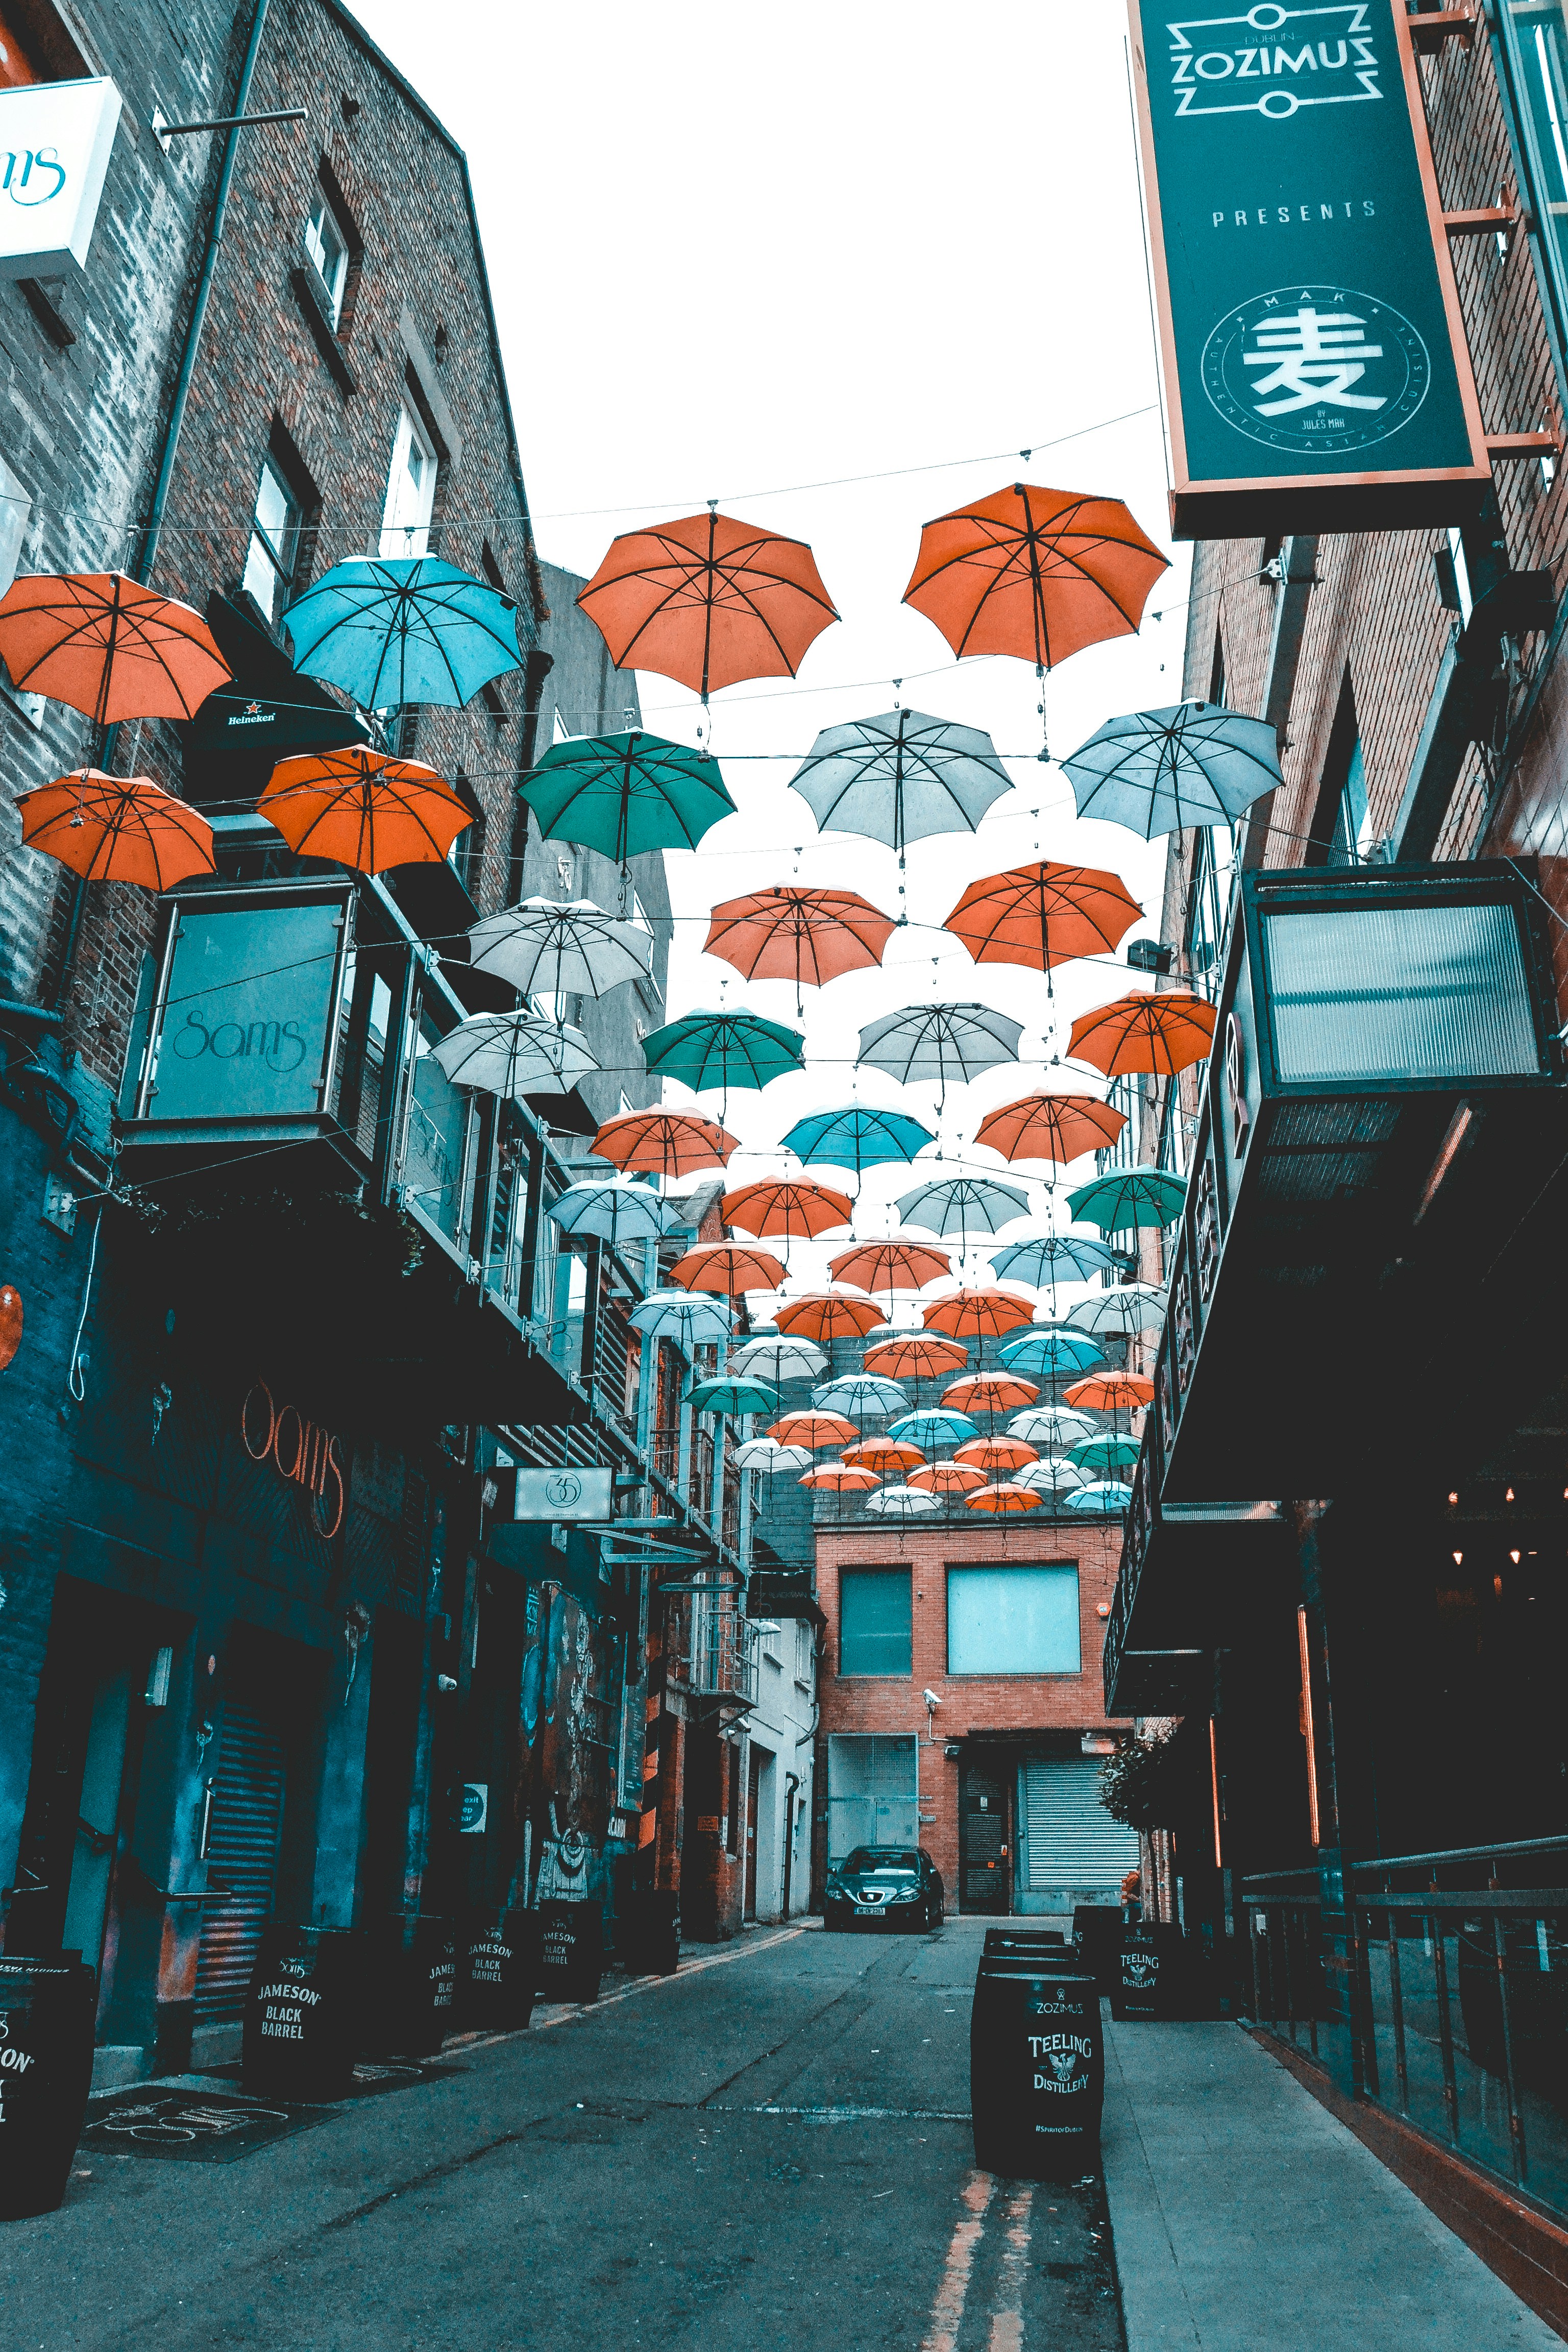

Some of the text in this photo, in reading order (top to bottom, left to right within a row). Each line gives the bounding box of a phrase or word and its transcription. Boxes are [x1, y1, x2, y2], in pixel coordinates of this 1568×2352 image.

[1244, 32, 1295, 45] DUBLIN
[1170, 37, 1379, 83] ZOZIMUS
[1212, 201, 1376, 228] PRESENTS
[1264, 290, 1344, 307] MAK
[1243, 307, 1388, 417] 麦
[1210, 336, 1278, 440] AUTHENTIC
[1398, 326, 1423, 411] CUISINE
[1317, 409, 1326, 418] BY
[1302, 419, 1326, 430] JULES
[228, 714, 276, 725] Heineken
[173, 1010, 307, 1073] Sams
[549, 1478, 578, 1503] 35
[469, 1943, 513, 1958] JAMESON
[545, 1945, 566, 1954] BLACK
[475, 1958, 501, 1970] BLACK
[543, 1955, 568, 1964] BARREL
[1120, 1953, 1159, 1969] TEELING
[472, 1970, 502, 1982] BARREL
[258, 1984, 322, 2006] JAMESON
[266, 2005, 302, 2022] BLACK
[1036, 2003, 1083, 2014] ZOZIMUS
[261, 2021, 304, 2039] BARREL
[1028, 2033, 1092, 2058] TEELING
